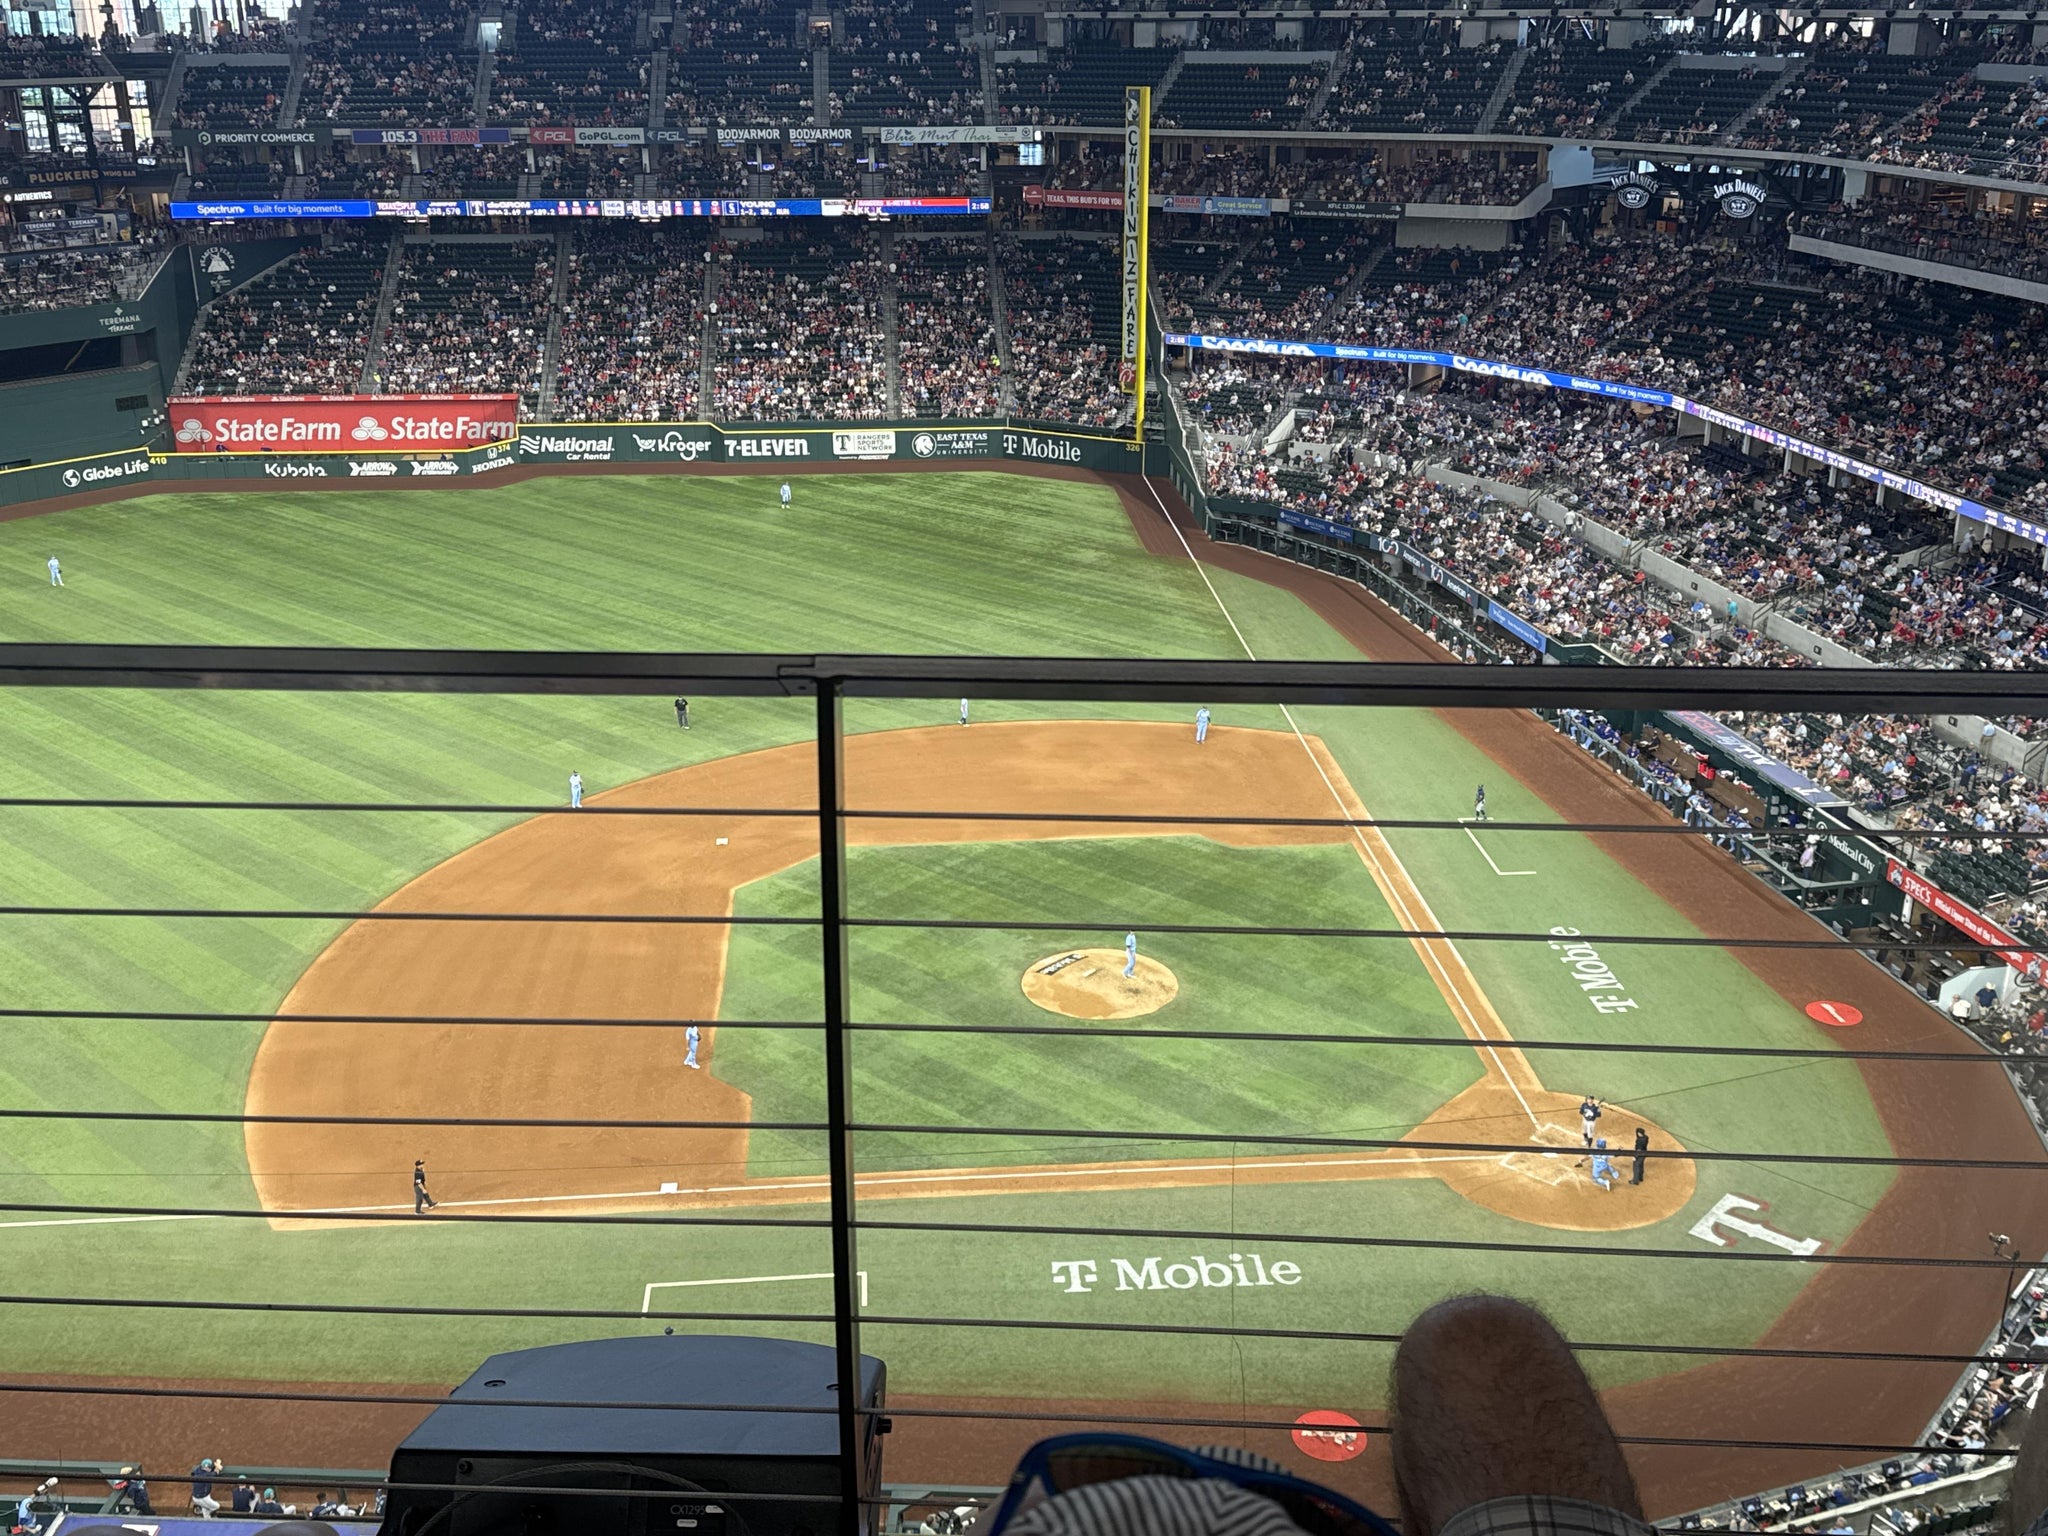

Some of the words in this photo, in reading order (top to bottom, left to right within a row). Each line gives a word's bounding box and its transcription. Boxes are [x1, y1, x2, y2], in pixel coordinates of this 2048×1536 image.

[215, 133, 259, 143] PRIORITY
[261, 133, 315, 143] COMMERCE
[381, 131, 418, 143] 105.3
[419, 131, 448, 143] THE
[450, 131, 479, 143] FAN
[543, 131, 572, 142] PGL
[579, 132, 641, 142] GoPGL.com
[657, 131, 685, 141] PGL
[717, 129, 780, 140] BODYARMOR
[789, 129, 852, 140] BODYARMOR
[883, 129, 917, 142] Blue
[920, 128, 958, 142] Mint
[962, 128, 992, 142] Thai
[29, 169, 99, 184] PLUCKERS
[1127, 128, 1138, 233] CHIKIN
[1610, 174, 1629, 190] JACK
[14, 191, 53, 201] AUTHENTICS
[1713, 182, 1734, 199] JACK
[1734, 178, 1767, 204] DANIEL'S
[1047, 194, 1066, 203] TEXAS,
[1066, 194, 1080, 203] THIS
[1080, 196, 1097, 204] BUD'S
[1098, 197, 1110, 205] FOR
[1111, 198, 1123, 206] YOU
[197, 204, 244, 217] Spectrum
[253, 205, 271, 214] Built
[273, 205, 286, 214] for
[287, 205, 302, 218] big
[303, 206, 345, 214] moments.
[68, 218, 98, 227] TEREMANA
[1126, 243, 1137, 276] IZ
[99, 314, 141, 326] TEREMANA
[1125, 287, 1136, 356] FARE
[108, 324, 134, 333] TERRACE
[1373, 350, 1387, 358] Built
[1397, 352, 1407, 360] big
[1408, 353, 1437, 362] moments.
[1605, 384, 1618, 394] Built
[1618, 387, 1628, 395] for
[1628, 388, 1637, 398] big
[1637, 391, 1665, 402] moments.
[498, 444, 511, 453] 374
[540, 436, 612, 453] National
[658, 431, 711, 461] Kroger
[836, 435, 850, 451] T
[951, 440, 974, 449] A&M
[1022, 436, 1081, 462] Mobile
[1125, 444, 1141, 452] 326
[150, 456, 167, 464] 410
[566, 453, 581, 461] Car
[583, 452, 610, 461] Rental
[82, 464, 122, 482] Globe
[124, 460, 150, 475] Life
[265, 462, 328, 478] Kubota
[361, 462, 390, 471] ARROW
[424, 462, 452, 470] ARROW
[472, 456, 515, 474] HONDA
[1402, 550, 1421, 567] American
[1446, 579, 1467, 598] American
[1828, 834, 1859, 862] Medical
[1858, 852, 1875, 874] City
[1904, 876, 1932, 905] SPEC'S
[1950, 908, 1965, 924] Liquor
[1051, 1259, 1098, 1294] T
[1110, 1252, 1302, 1291] Mobile
